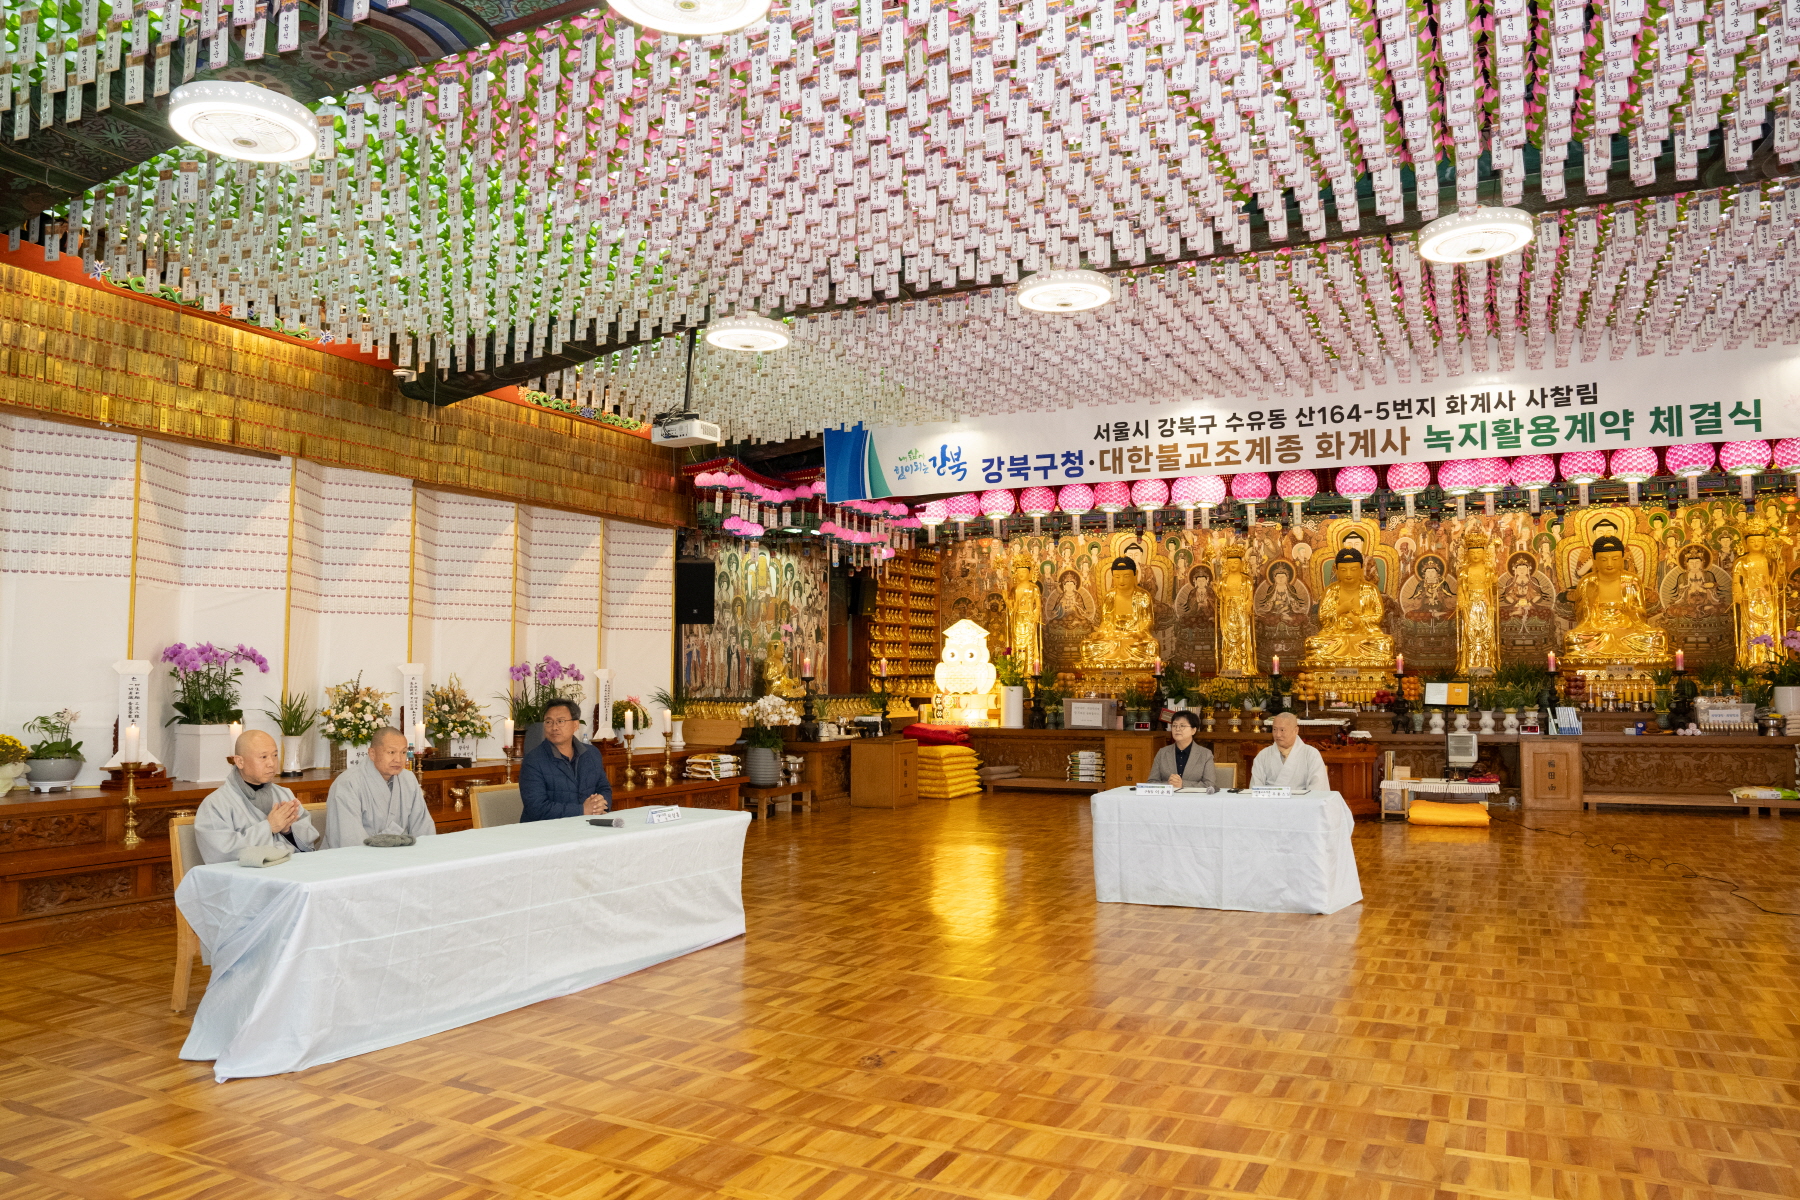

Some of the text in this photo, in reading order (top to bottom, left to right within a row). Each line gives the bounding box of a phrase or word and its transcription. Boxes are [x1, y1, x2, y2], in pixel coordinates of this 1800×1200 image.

[1094, 382, 1597, 442] 서울시 강북구 수유동 산164-5번지 화계사 사찰림
[1316, 426, 1410, 460] 화계사
[1422, 409, 1637, 453] 녹지활용계약
[1650, 399, 1761, 437] 체결식
[928, 444, 968, 481] 강북
